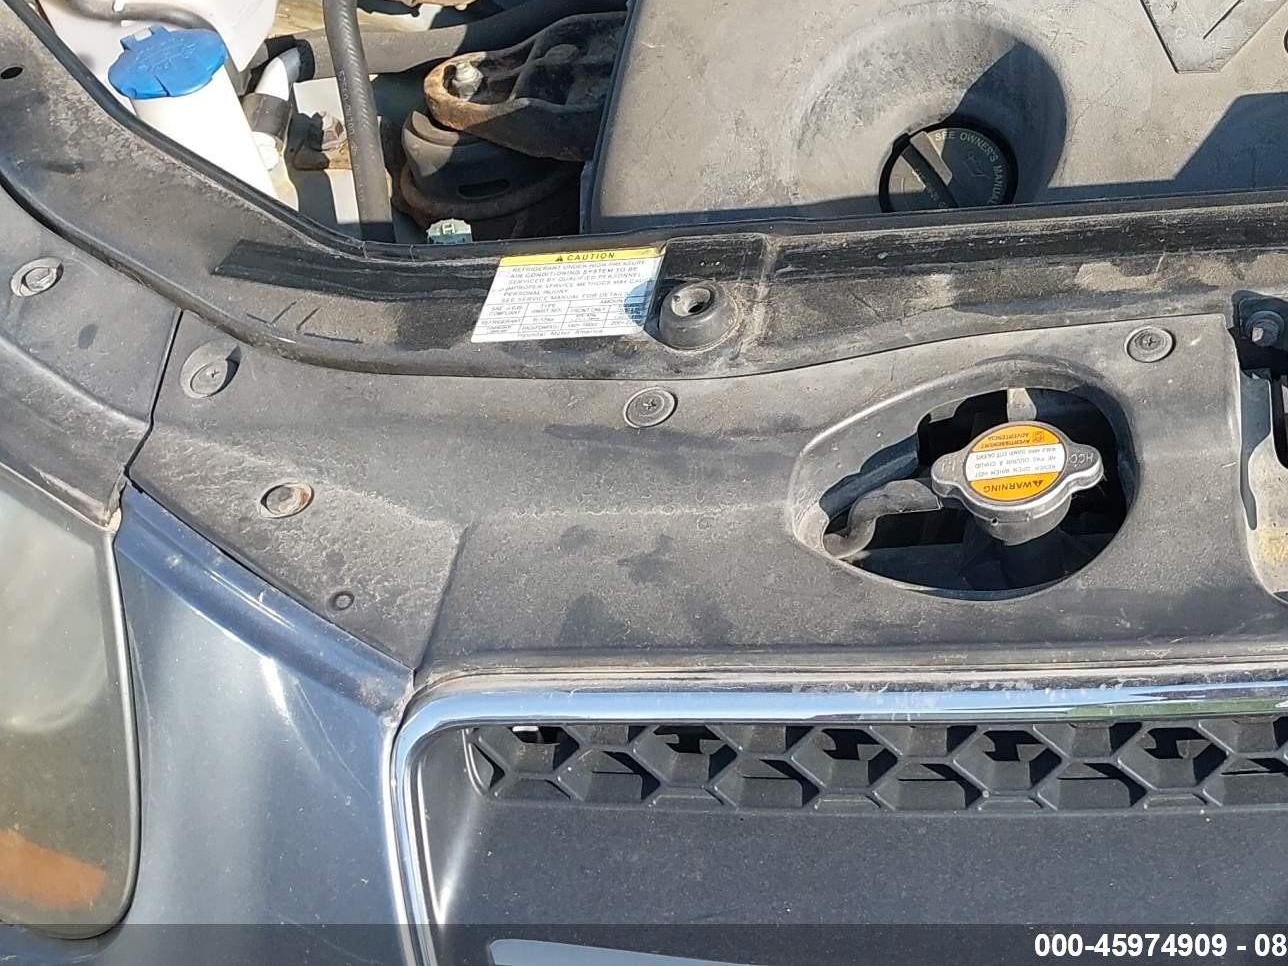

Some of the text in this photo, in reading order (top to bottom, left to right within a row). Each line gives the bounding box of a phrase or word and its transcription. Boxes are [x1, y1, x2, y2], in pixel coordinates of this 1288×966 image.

[935, 130, 956, 141] SEE
[960, 132, 999, 162] OWNER'S
[567, 252, 615, 260] CAUTION
[984, 482, 1032, 492] WARNING
